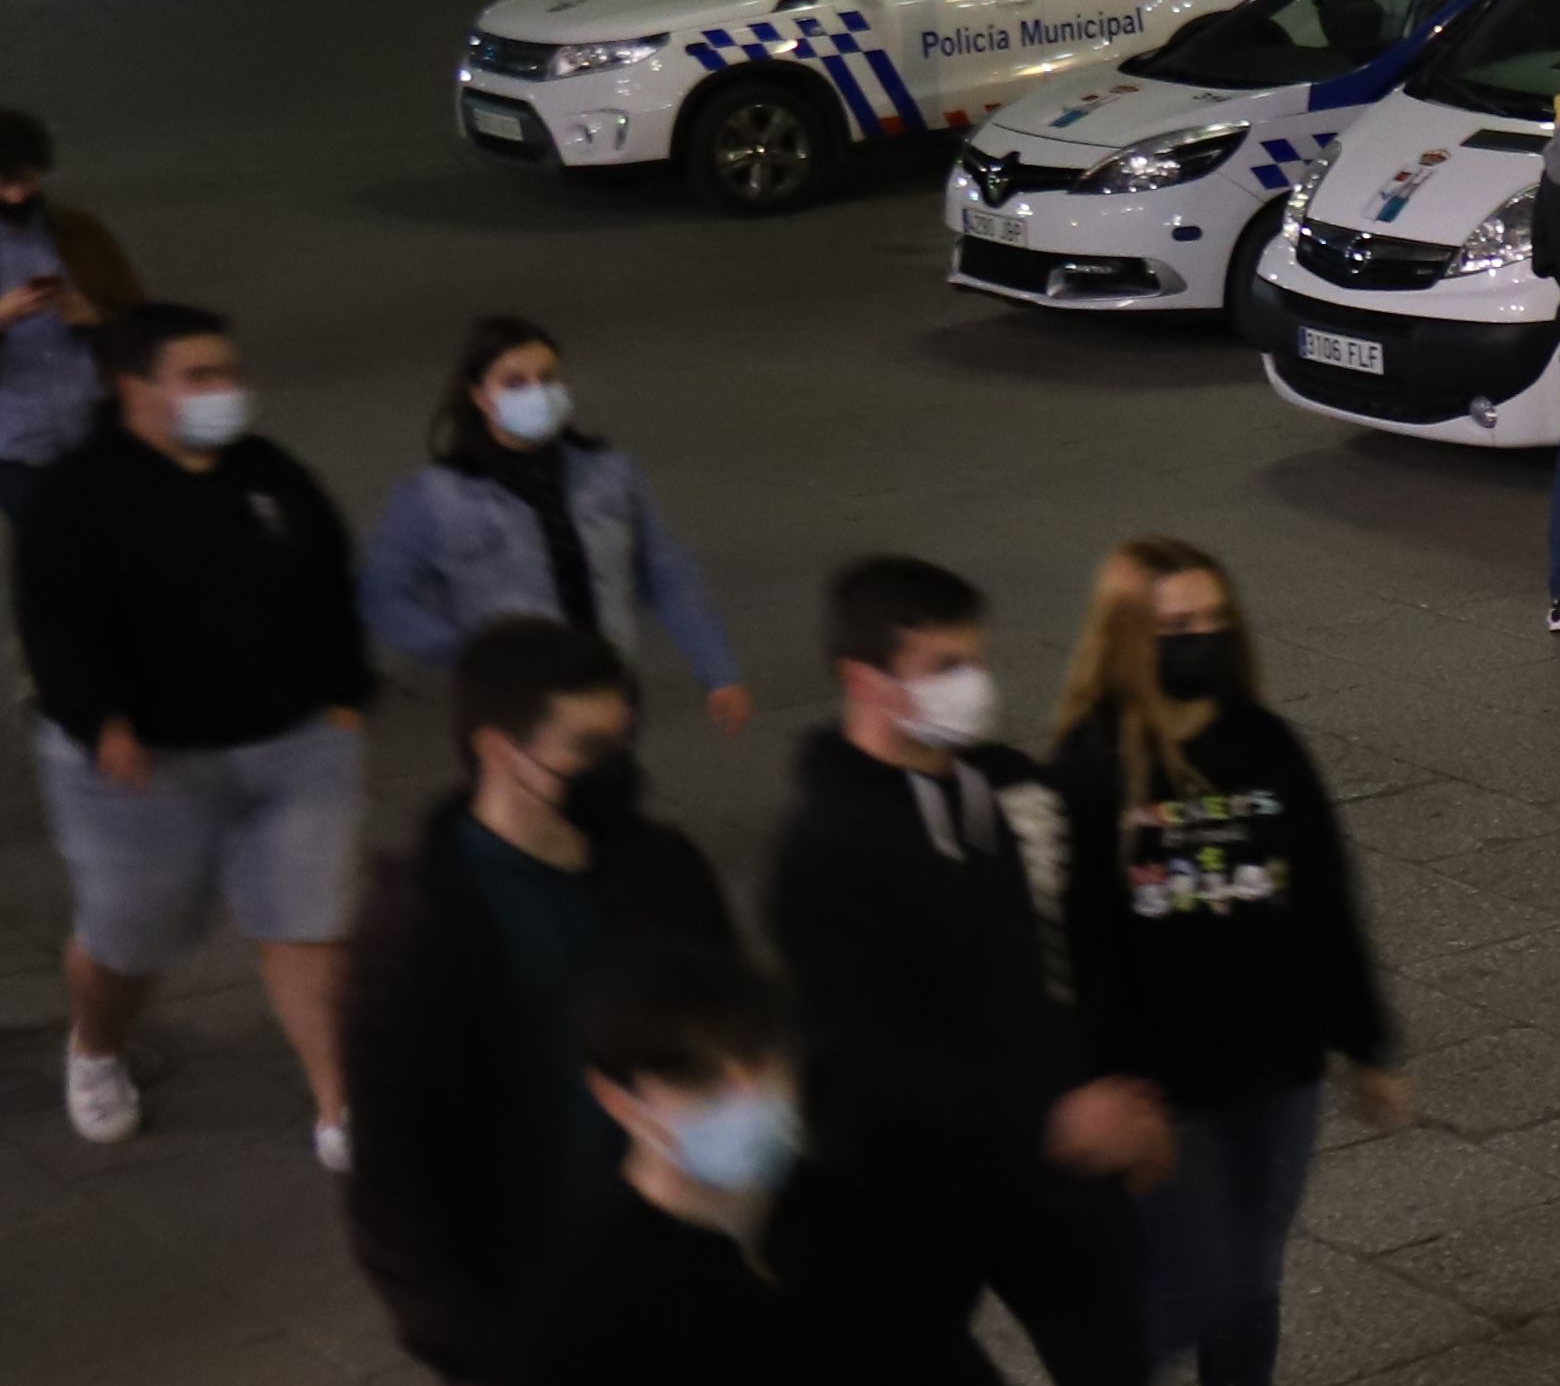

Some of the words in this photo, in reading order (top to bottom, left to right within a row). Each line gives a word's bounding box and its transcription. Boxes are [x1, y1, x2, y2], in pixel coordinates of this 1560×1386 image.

[921, 24, 1011, 60] Policía
[1020, 7, 1144, 48] Municipal
[1306, 332, 1341, 361] 3106
[1347, 342, 1379, 369] FLF
